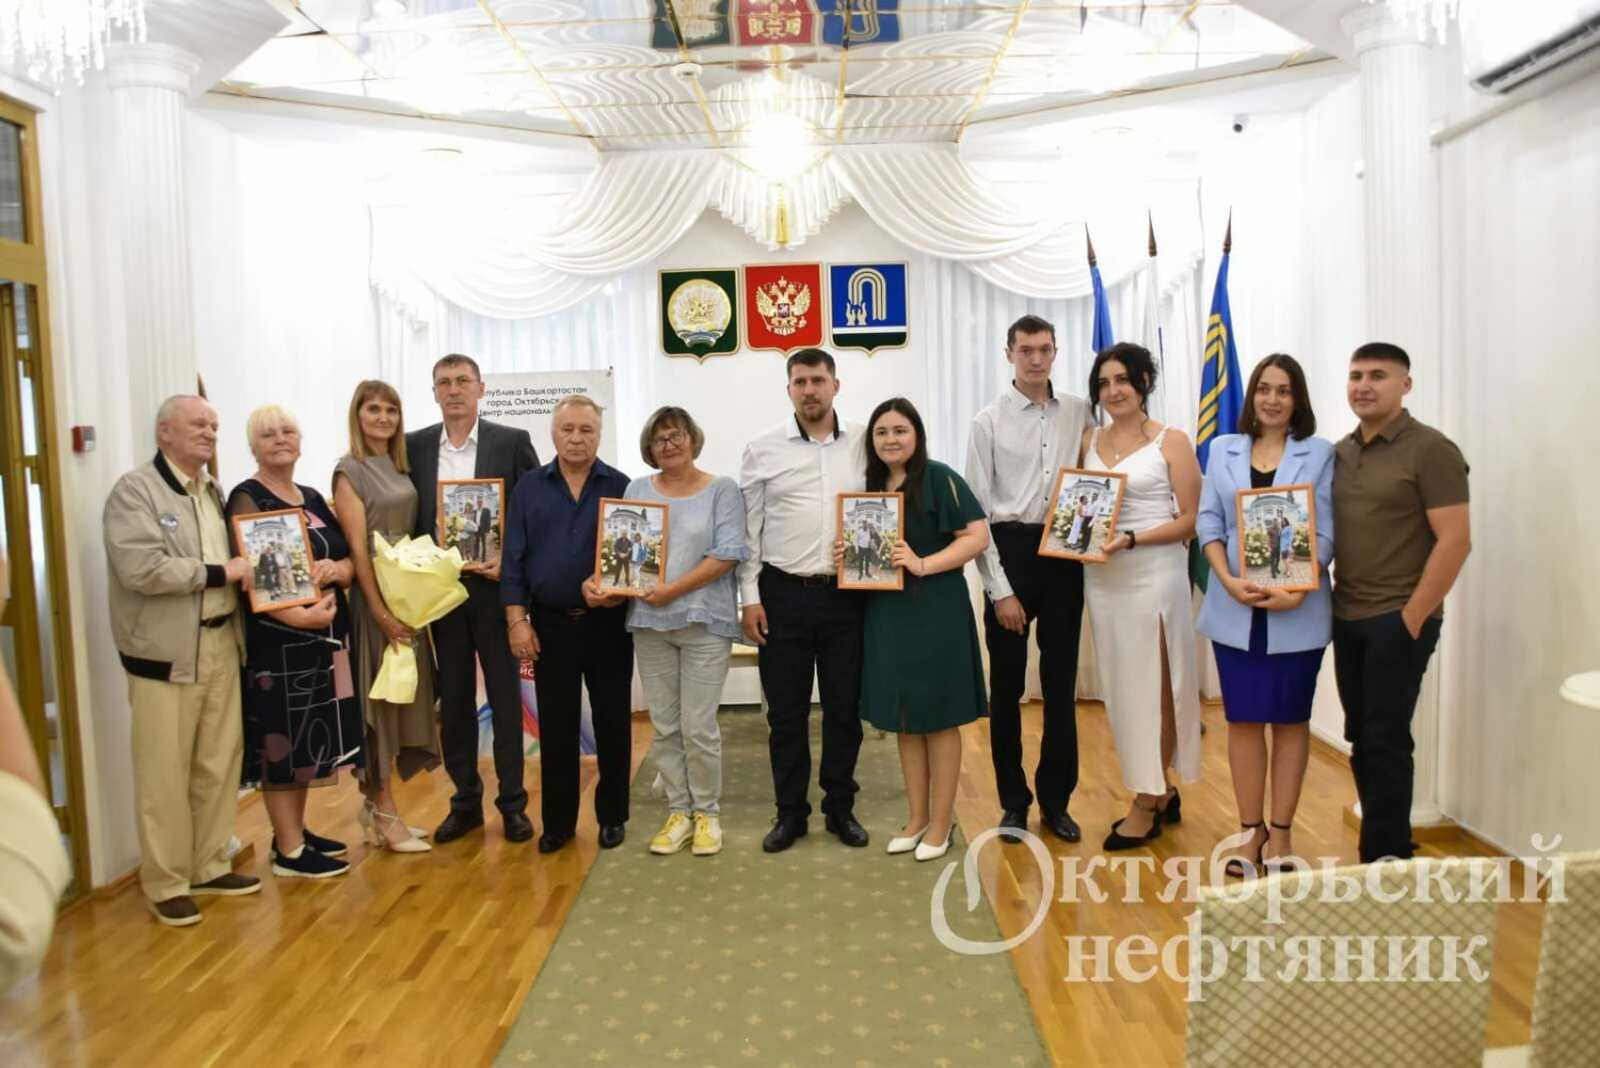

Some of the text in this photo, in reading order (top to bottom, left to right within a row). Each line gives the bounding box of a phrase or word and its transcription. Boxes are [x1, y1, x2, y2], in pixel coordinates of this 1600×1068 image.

[486, 386, 588, 398] публика Башкортостан
[486, 397, 560, 408] город Октябрьск
[504, 408, 553, 417] националь
